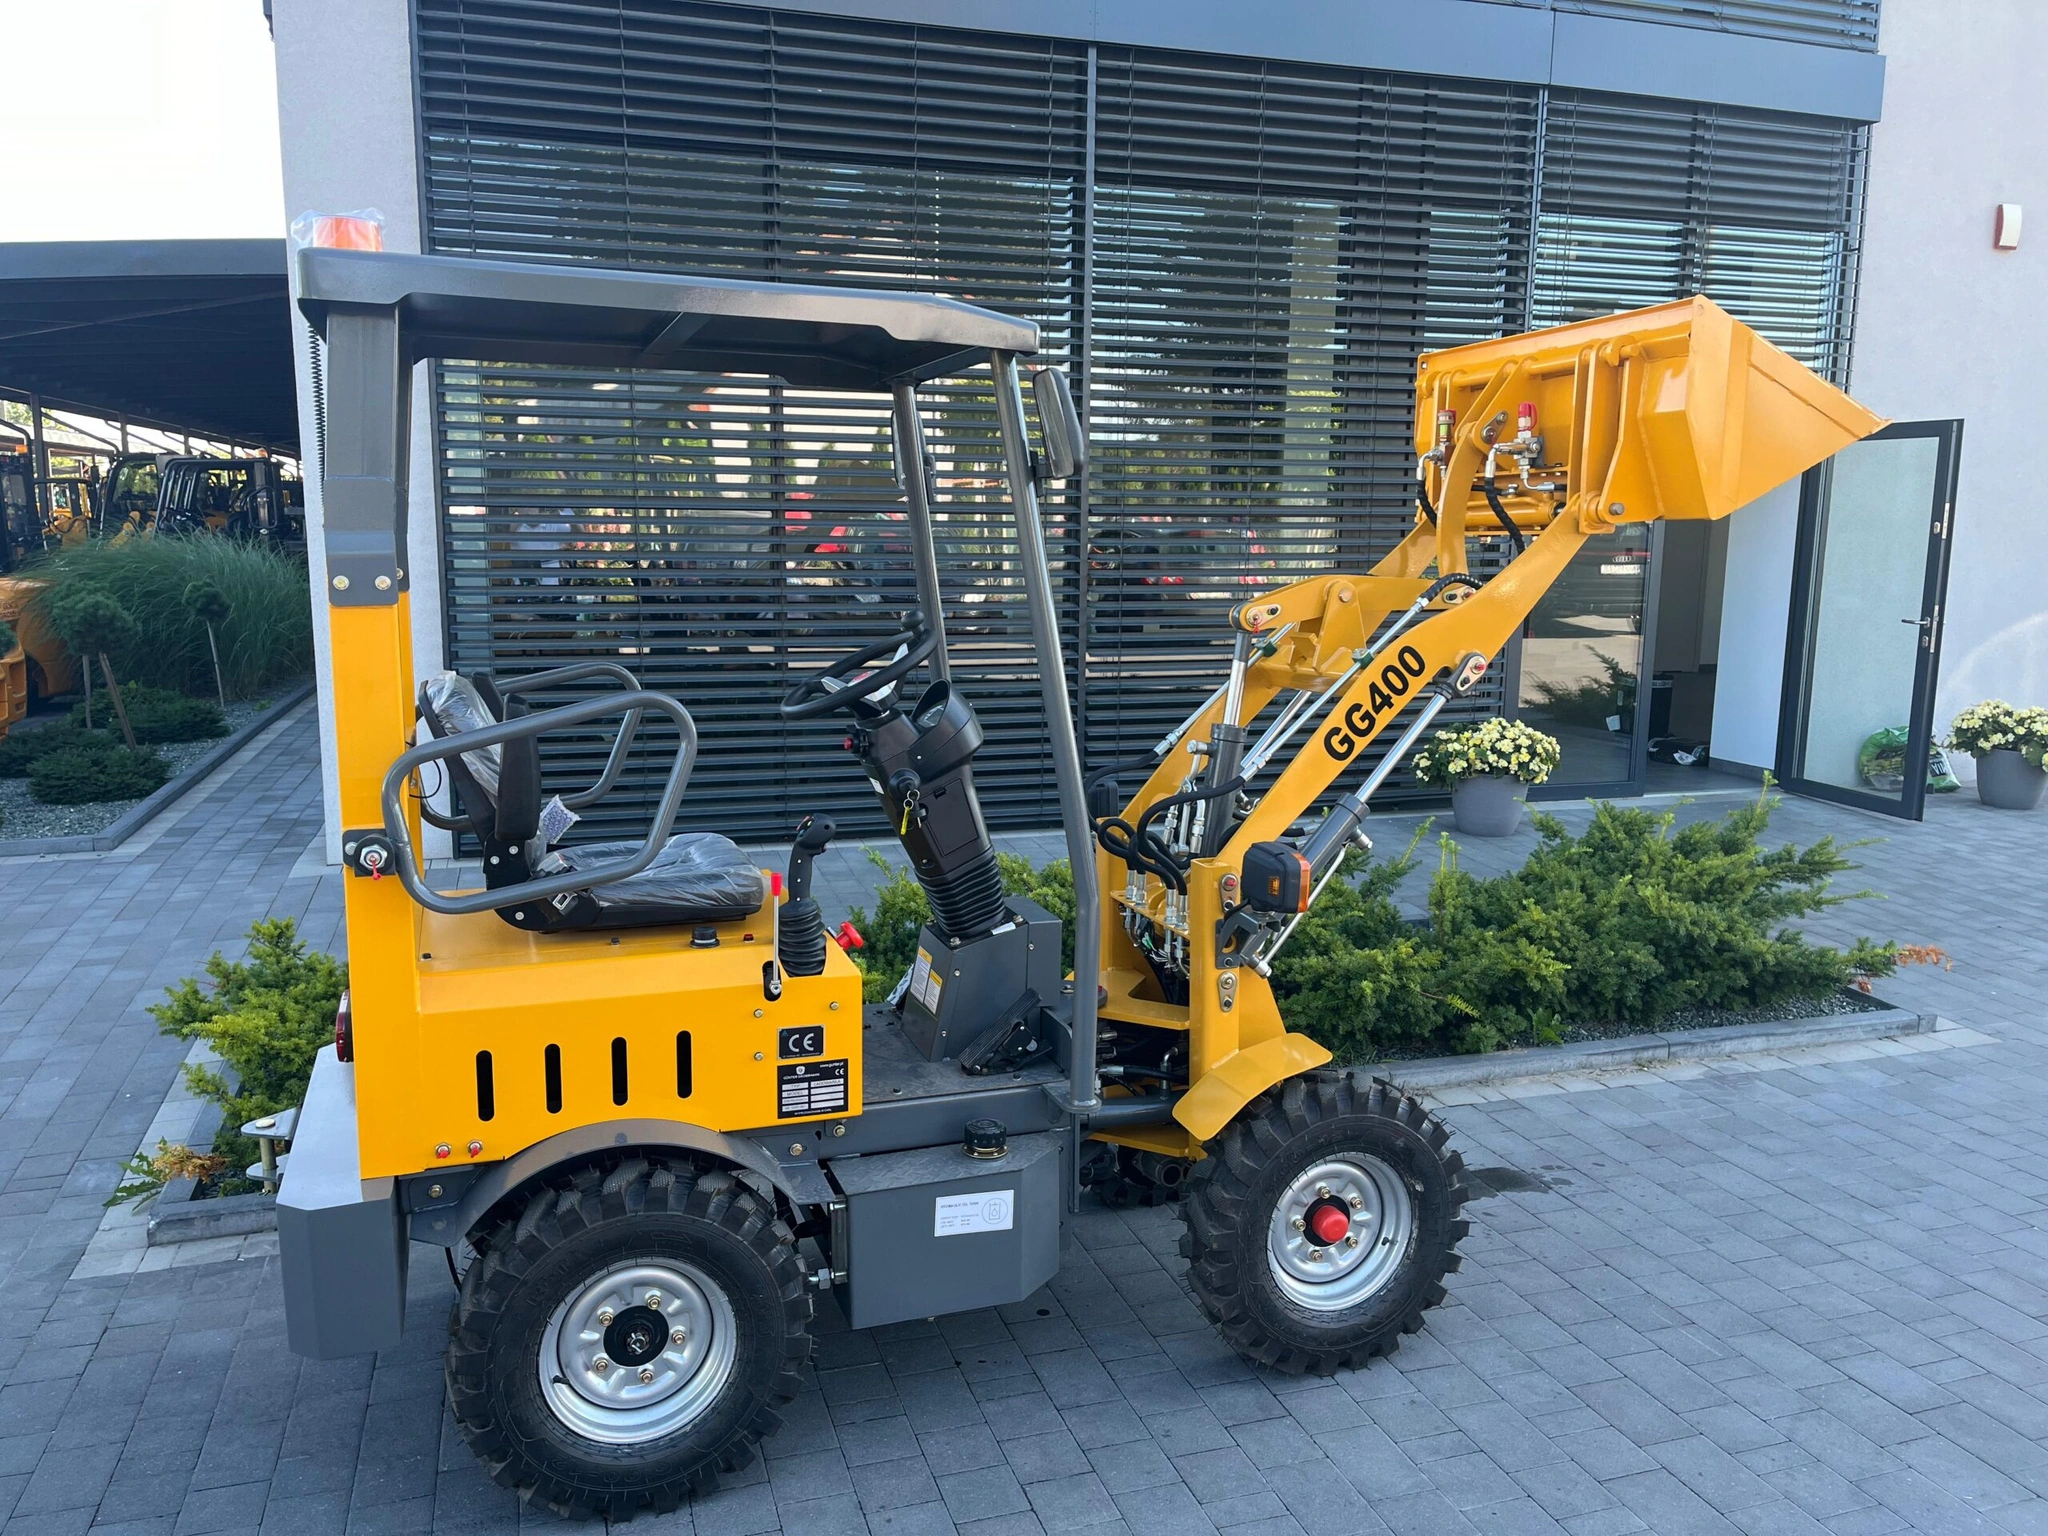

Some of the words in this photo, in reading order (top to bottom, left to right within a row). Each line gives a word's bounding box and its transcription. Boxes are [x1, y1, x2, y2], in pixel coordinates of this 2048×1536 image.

[1324, 645, 1425, 761] GG400
[788, 1033, 814, 1052] CE
[835, 1068, 845, 1076] CE
